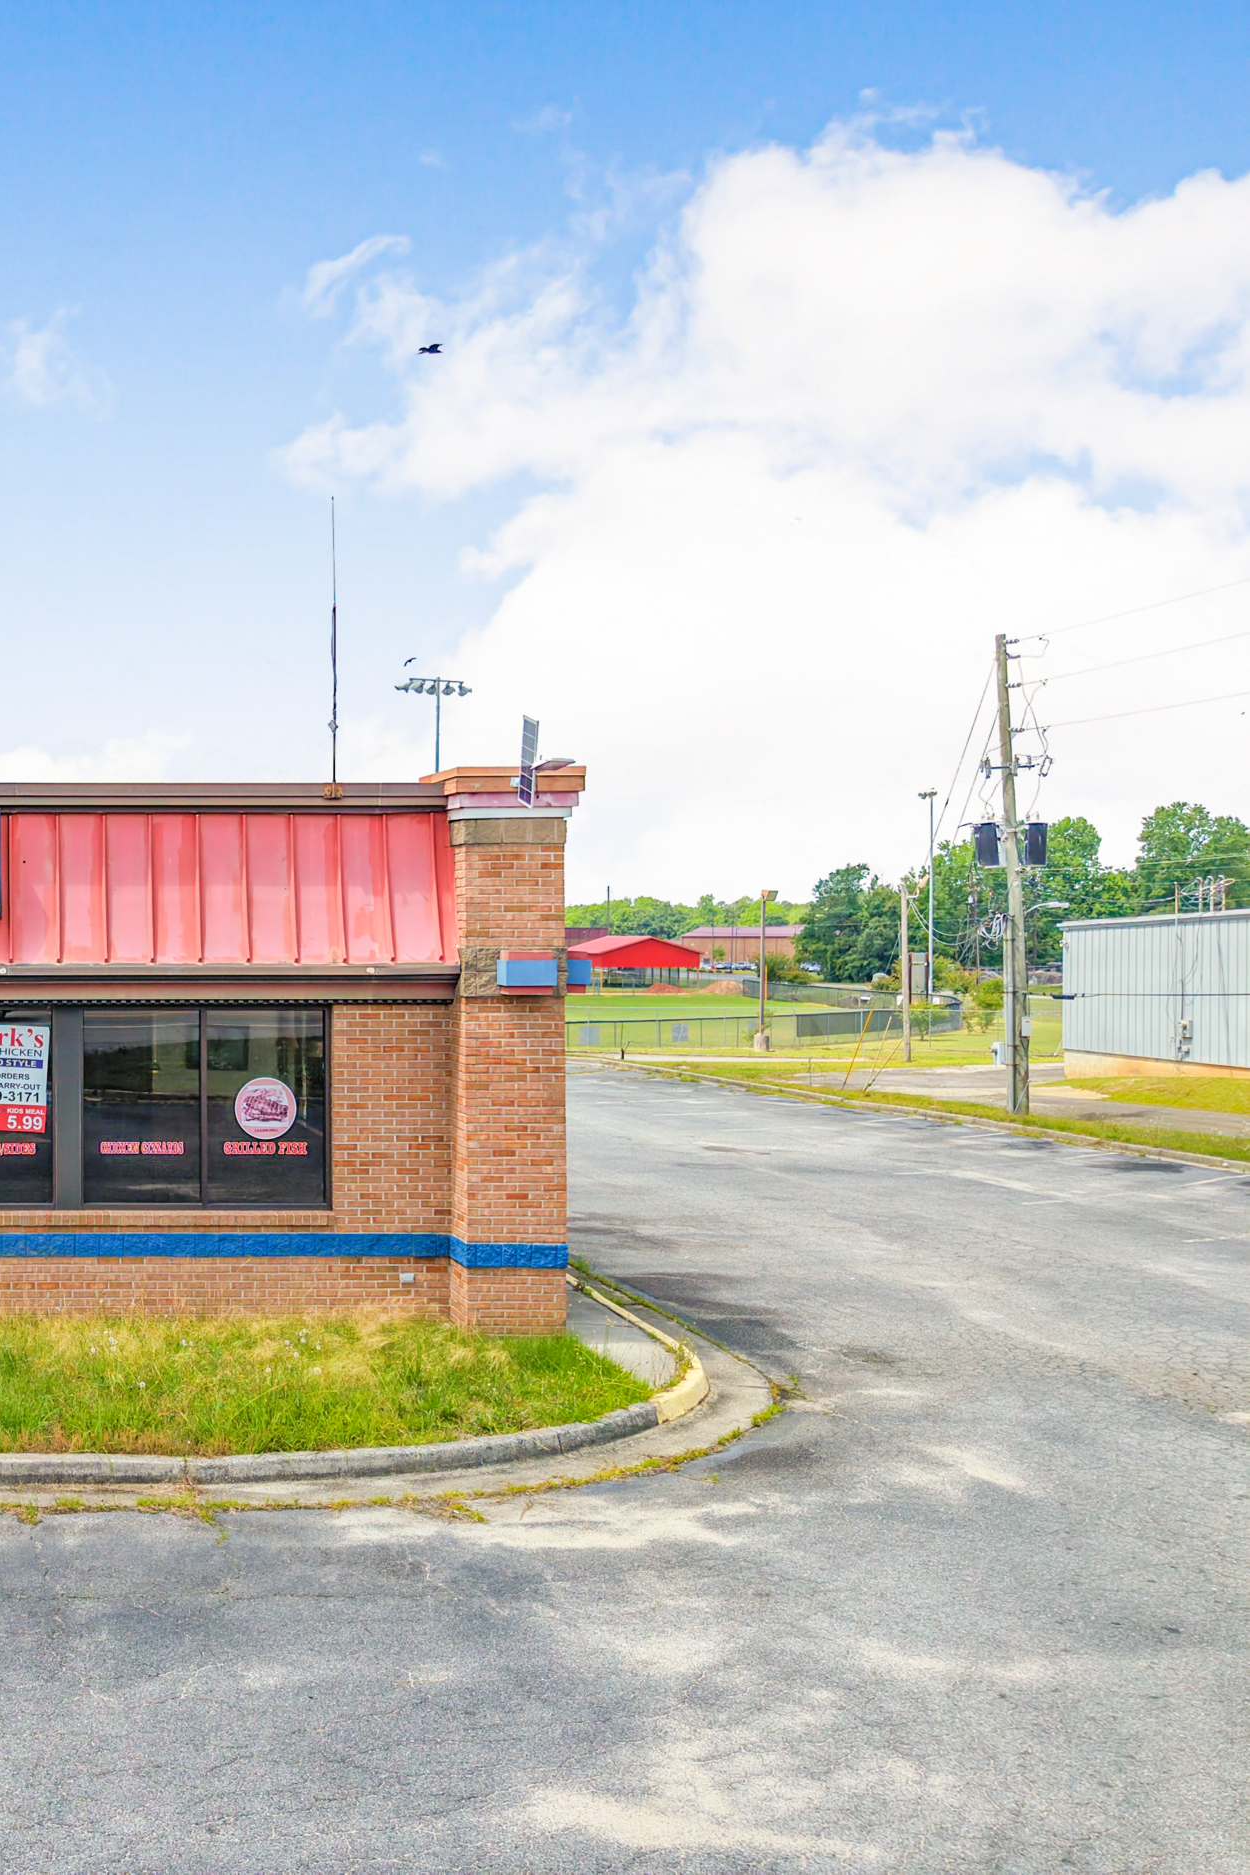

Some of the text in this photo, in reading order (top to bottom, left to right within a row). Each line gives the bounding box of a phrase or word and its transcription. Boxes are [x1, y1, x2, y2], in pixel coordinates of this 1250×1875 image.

[5, 1059, 37, 1067] STYLE
[6, 1115, 43, 1130] 5.99
[100, 1141, 184, 1155] CHICKEN GIZZARDS
[223, 1141, 308, 1155] GRILLED FISH
